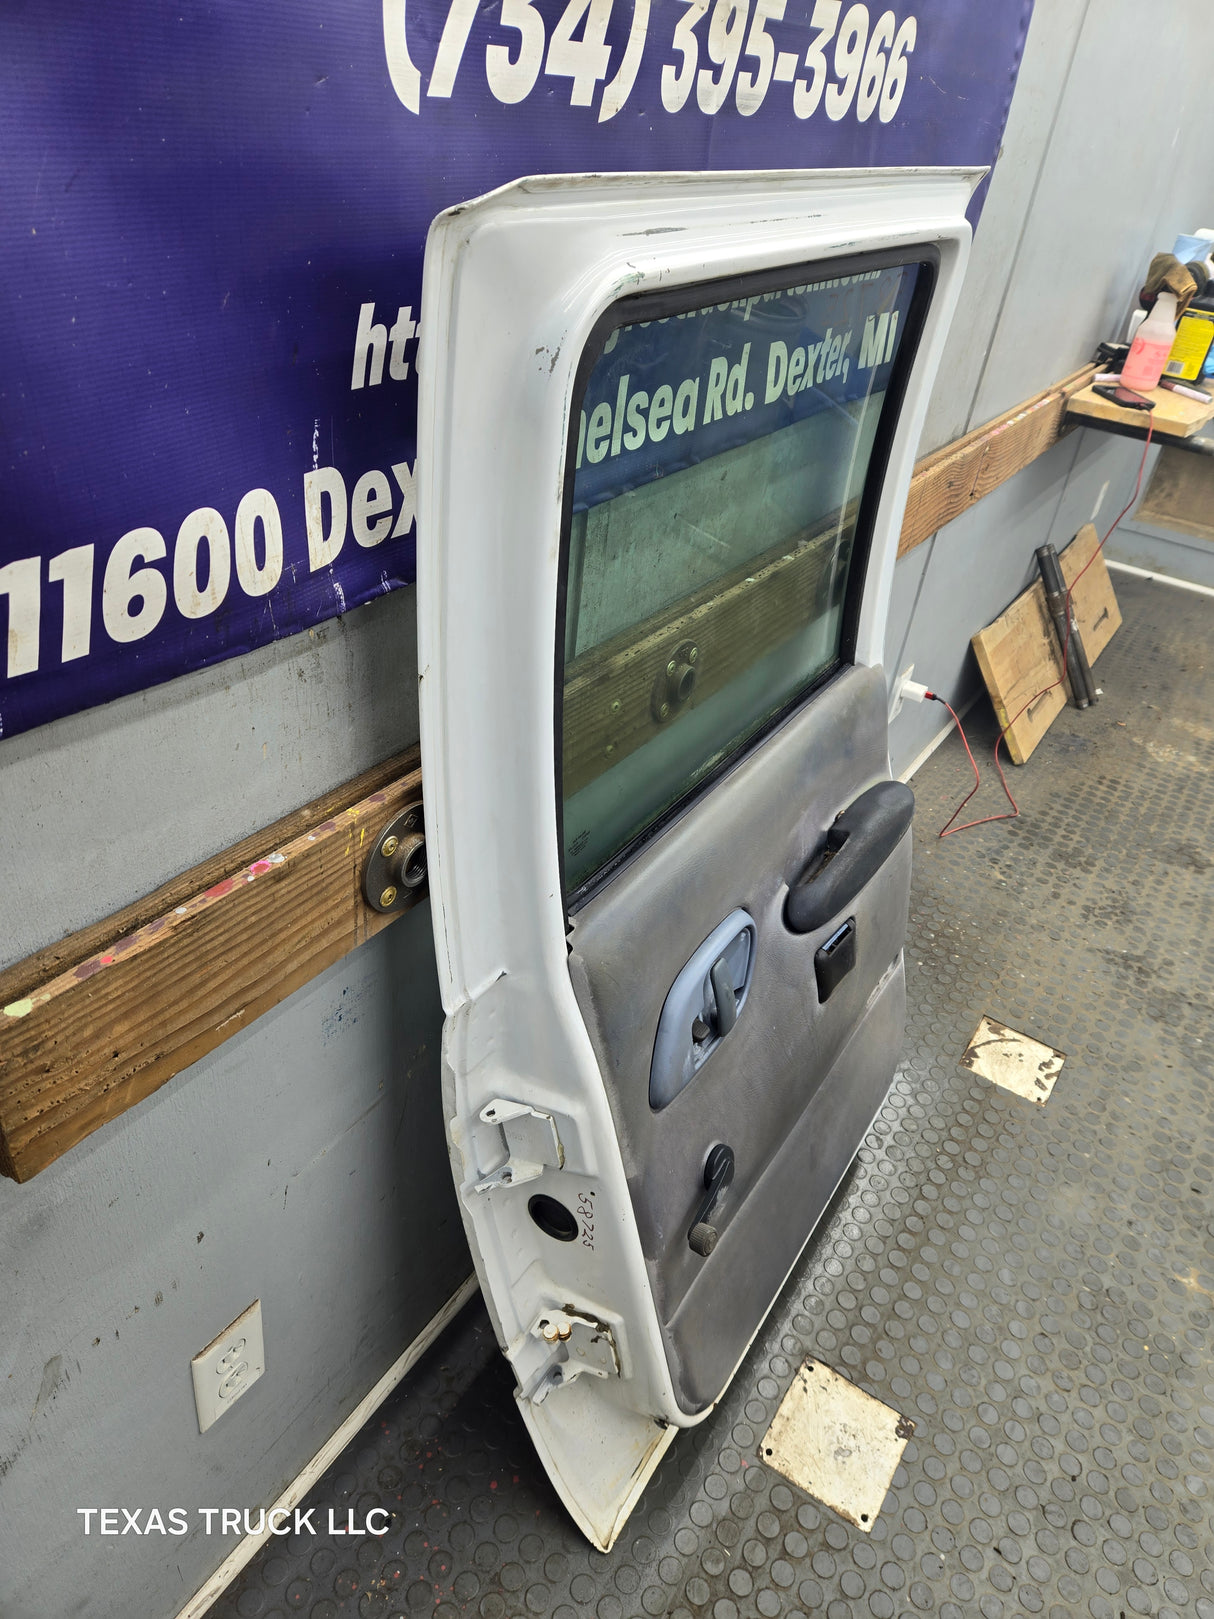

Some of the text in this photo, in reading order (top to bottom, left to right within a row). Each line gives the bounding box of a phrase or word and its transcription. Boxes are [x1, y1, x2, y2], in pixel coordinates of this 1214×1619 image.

[661, 0, 917, 123] 395-3966
[351, 303, 421, 390] ht
[0, 488, 284, 678] 11600
[702, 343, 754, 426] Rd.
[765, 327, 854, 405] Dexter,
[857, 310, 899, 370] MI
[577, 1192, 595, 1251] 58725
